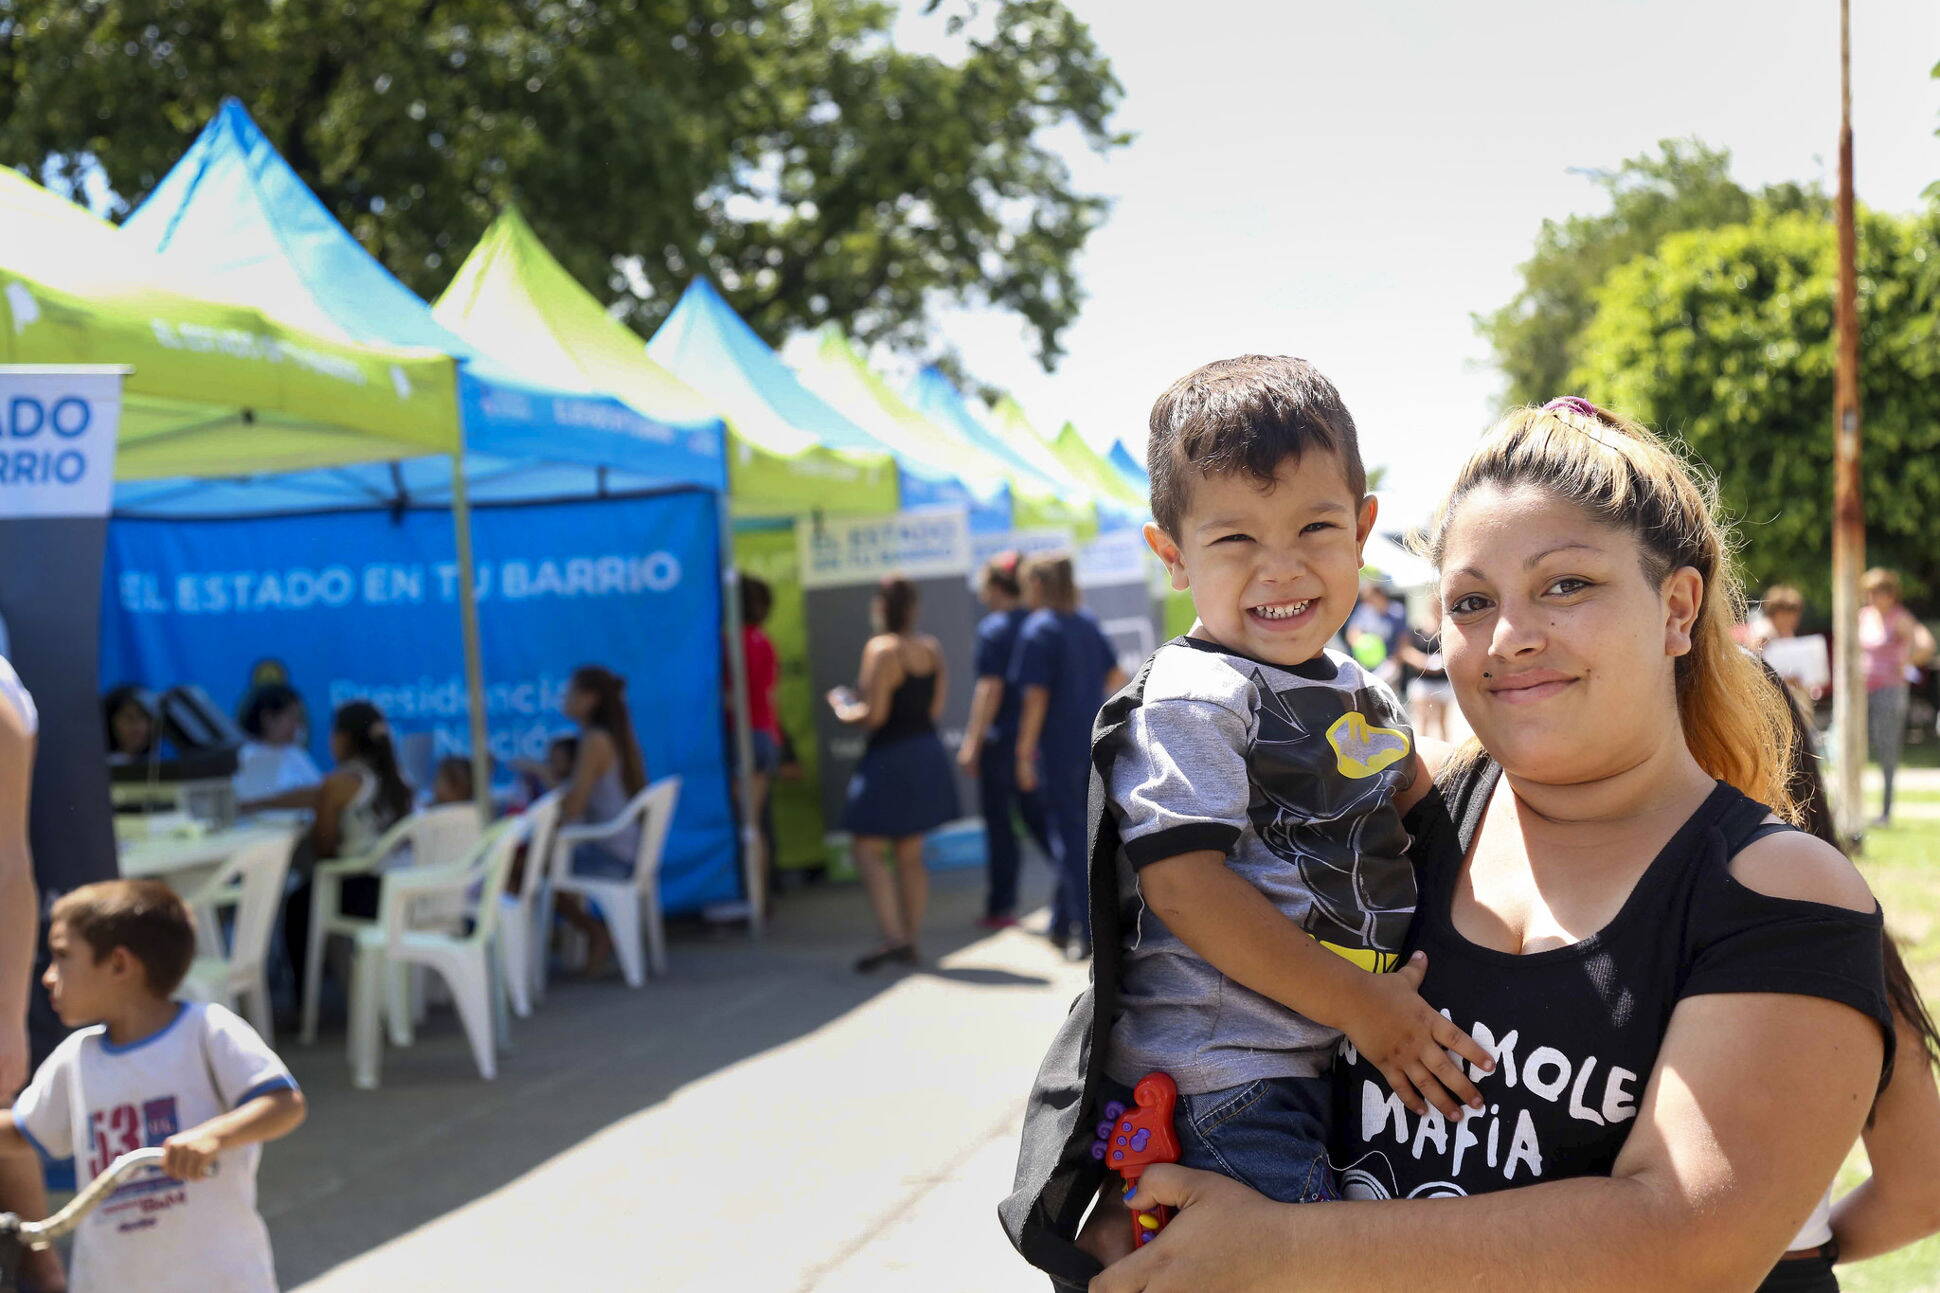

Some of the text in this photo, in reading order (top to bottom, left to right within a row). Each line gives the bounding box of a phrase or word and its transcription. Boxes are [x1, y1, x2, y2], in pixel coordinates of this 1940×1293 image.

[0, 396, 91, 437] DO
[120, 573, 166, 612] EL
[177, 567, 354, 614] ESTADO
[364, 564, 422, 602] EN
[503, 550, 682, 599] BARRIO
